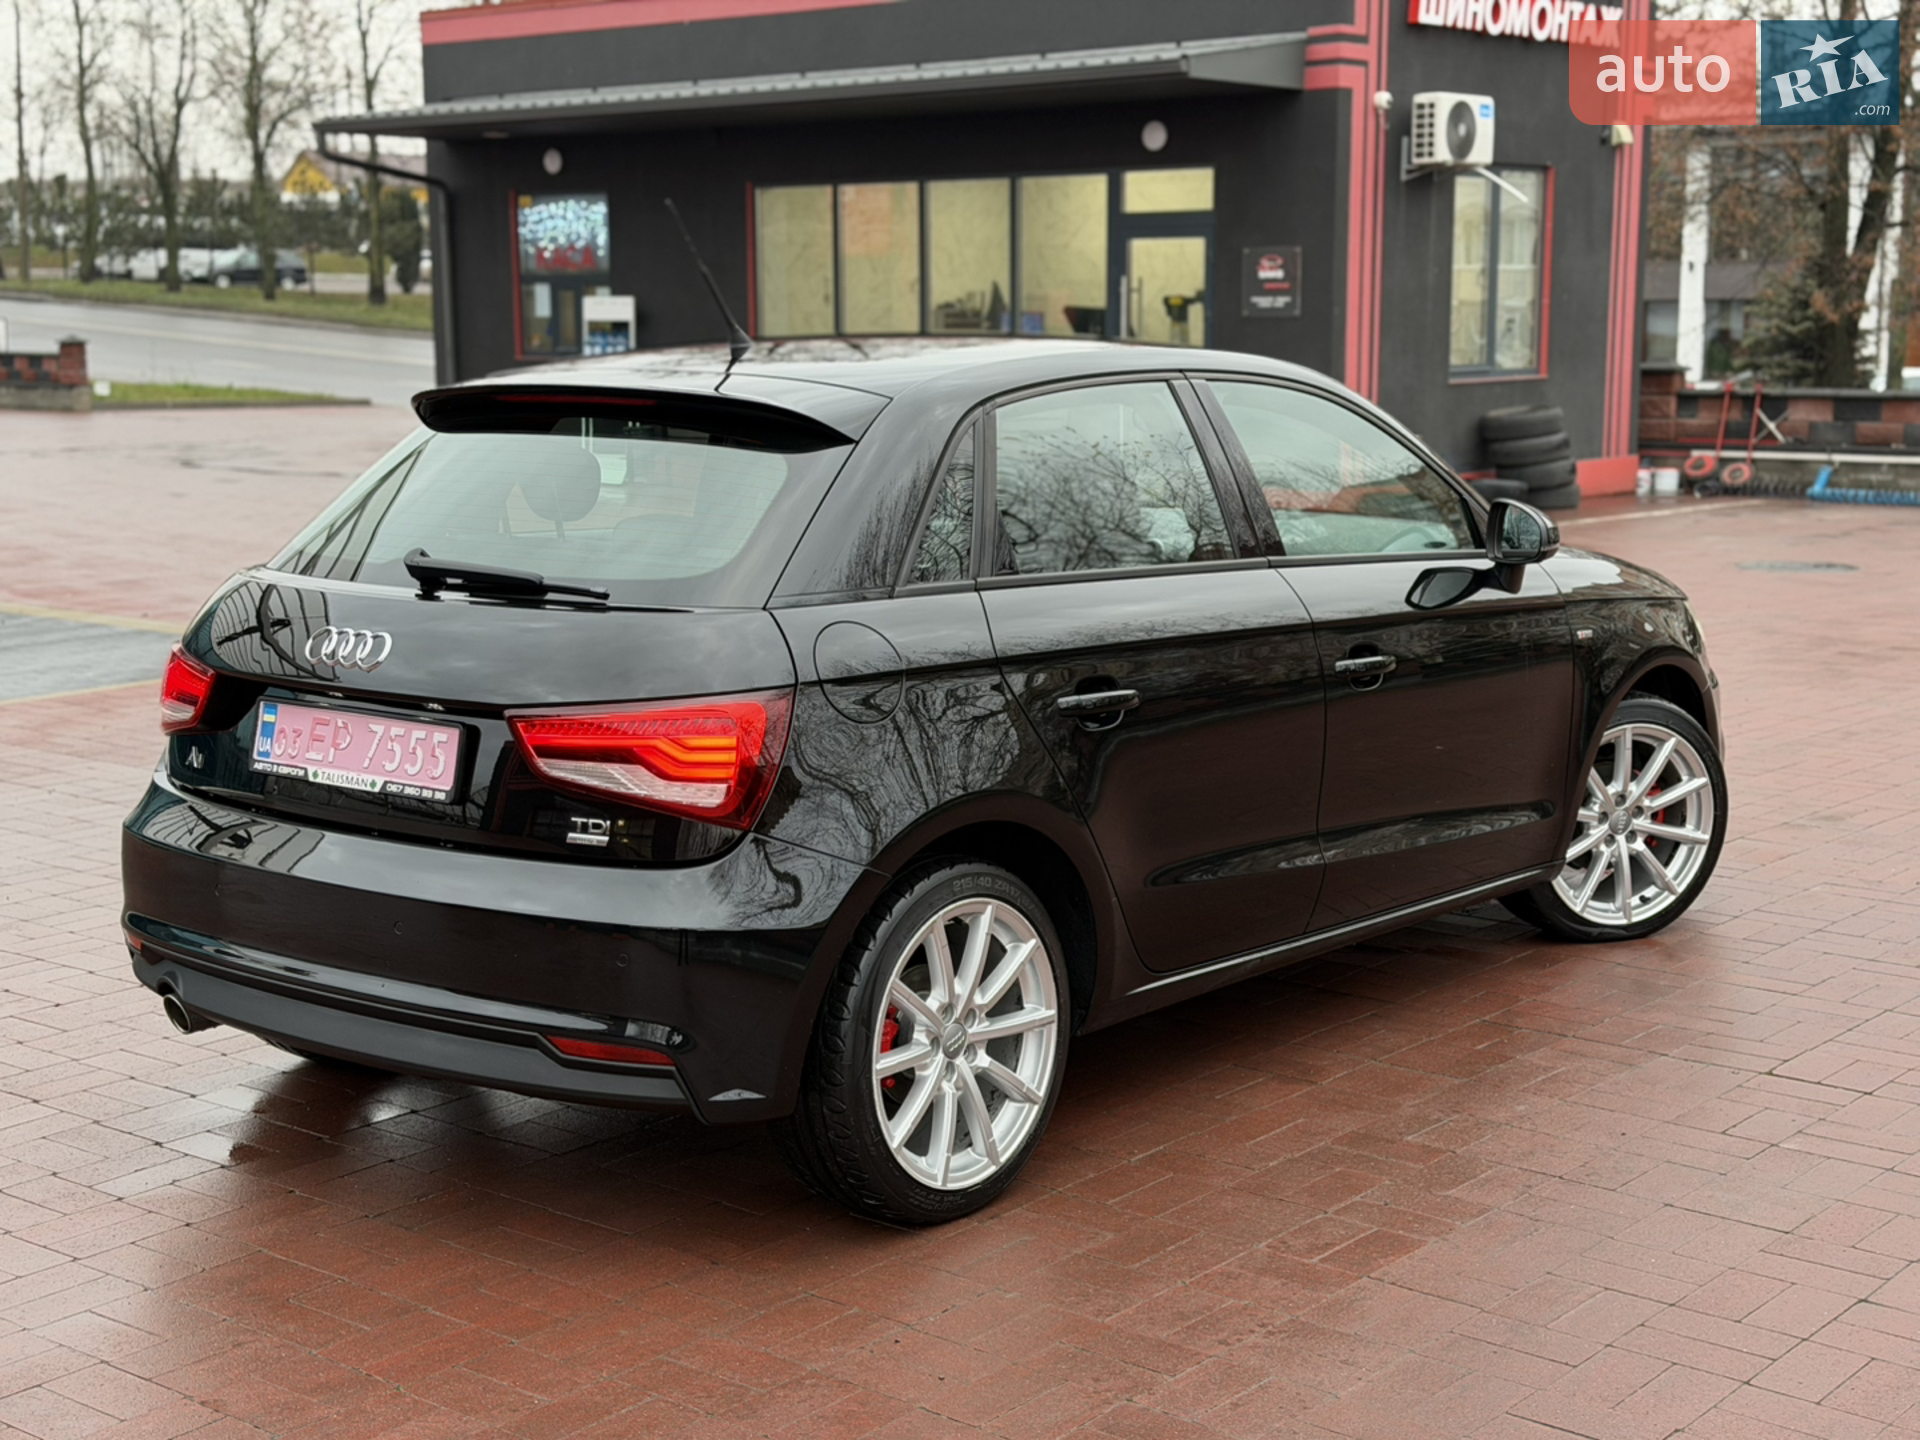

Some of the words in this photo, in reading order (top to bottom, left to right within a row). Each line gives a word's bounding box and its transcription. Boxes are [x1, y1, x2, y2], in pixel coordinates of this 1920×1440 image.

[1418, 0, 1623, 48] ШИНОМОНТАЖ
[259, 736, 271, 753] UA
[362, 722, 449, 780] 7555
[321, 771, 369, 788] TALISMAN
[571, 816, 611, 835] TDI
[952, 876, 992, 892] 215/40
